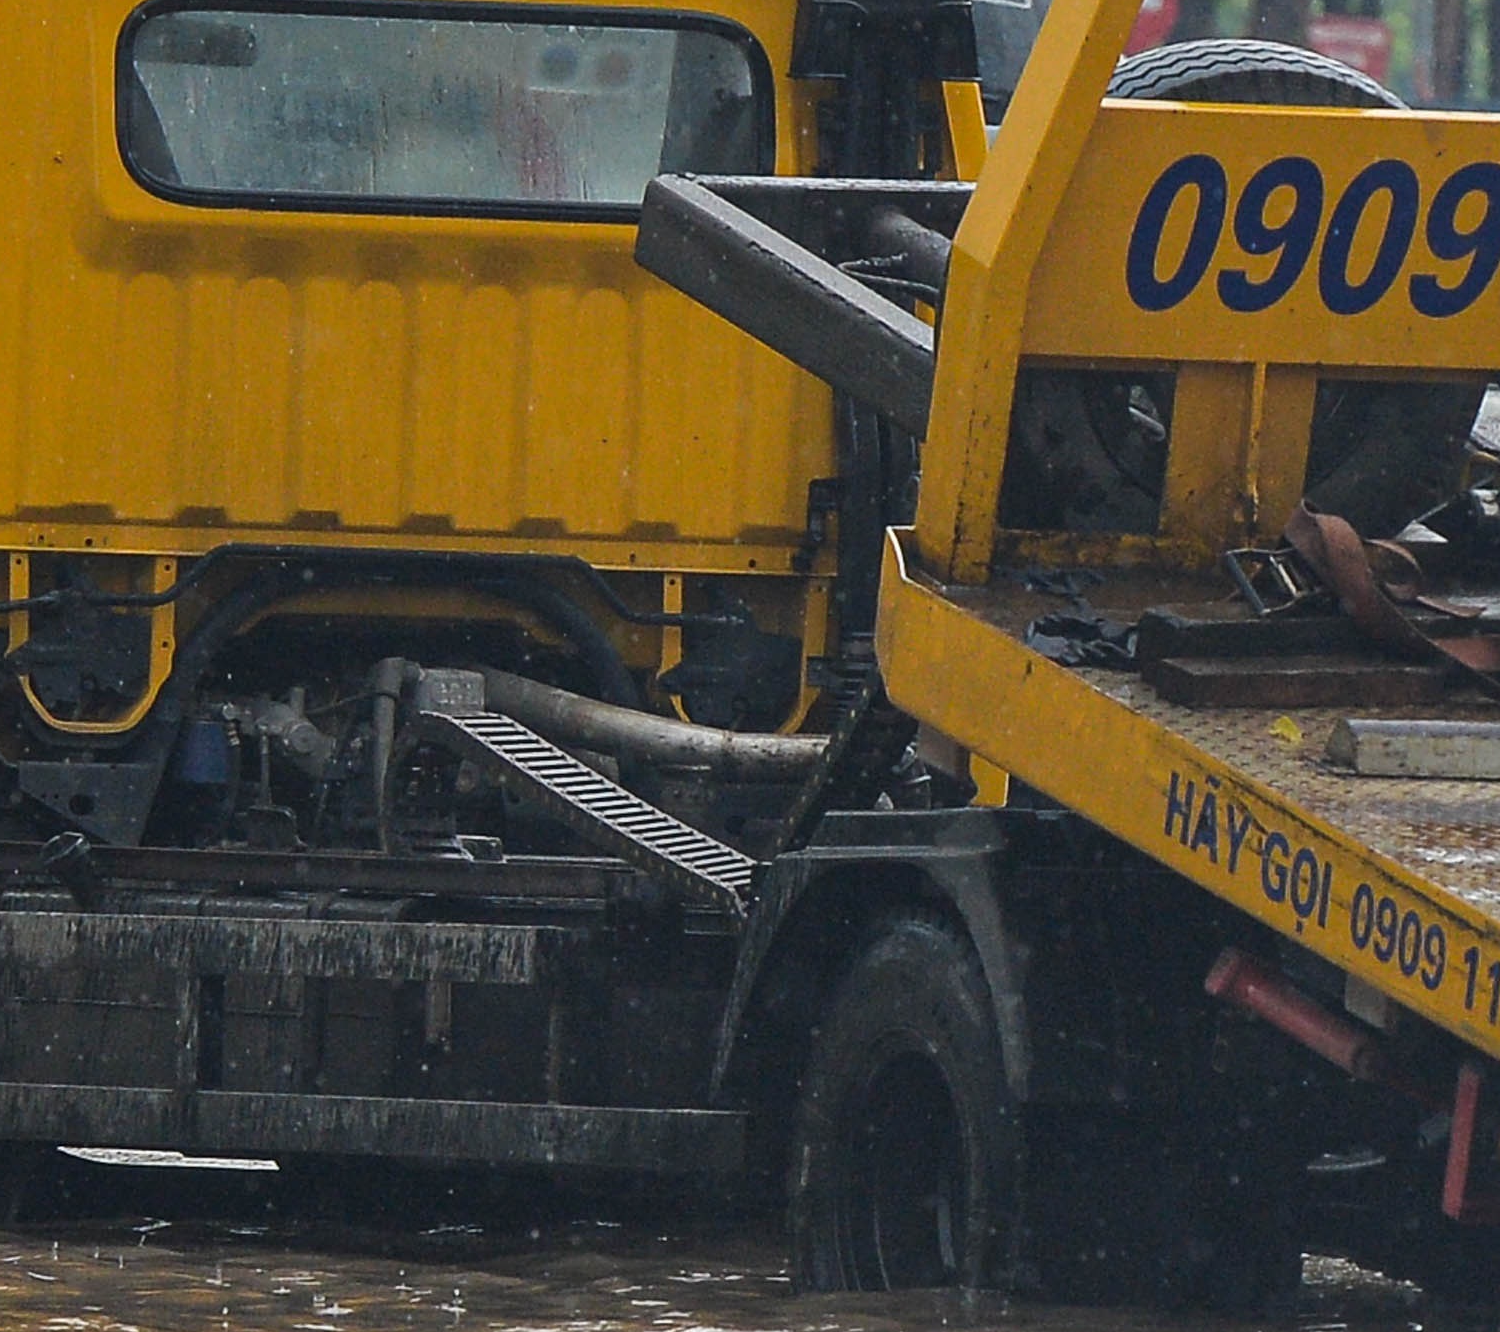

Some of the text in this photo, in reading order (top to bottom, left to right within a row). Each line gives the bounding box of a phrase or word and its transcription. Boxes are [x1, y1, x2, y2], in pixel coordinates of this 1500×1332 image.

[1164, 770, 1255, 875] HÃY
[1260, 830, 1333, 934] GỌI
[1348, 882, 1448, 991] 0909
